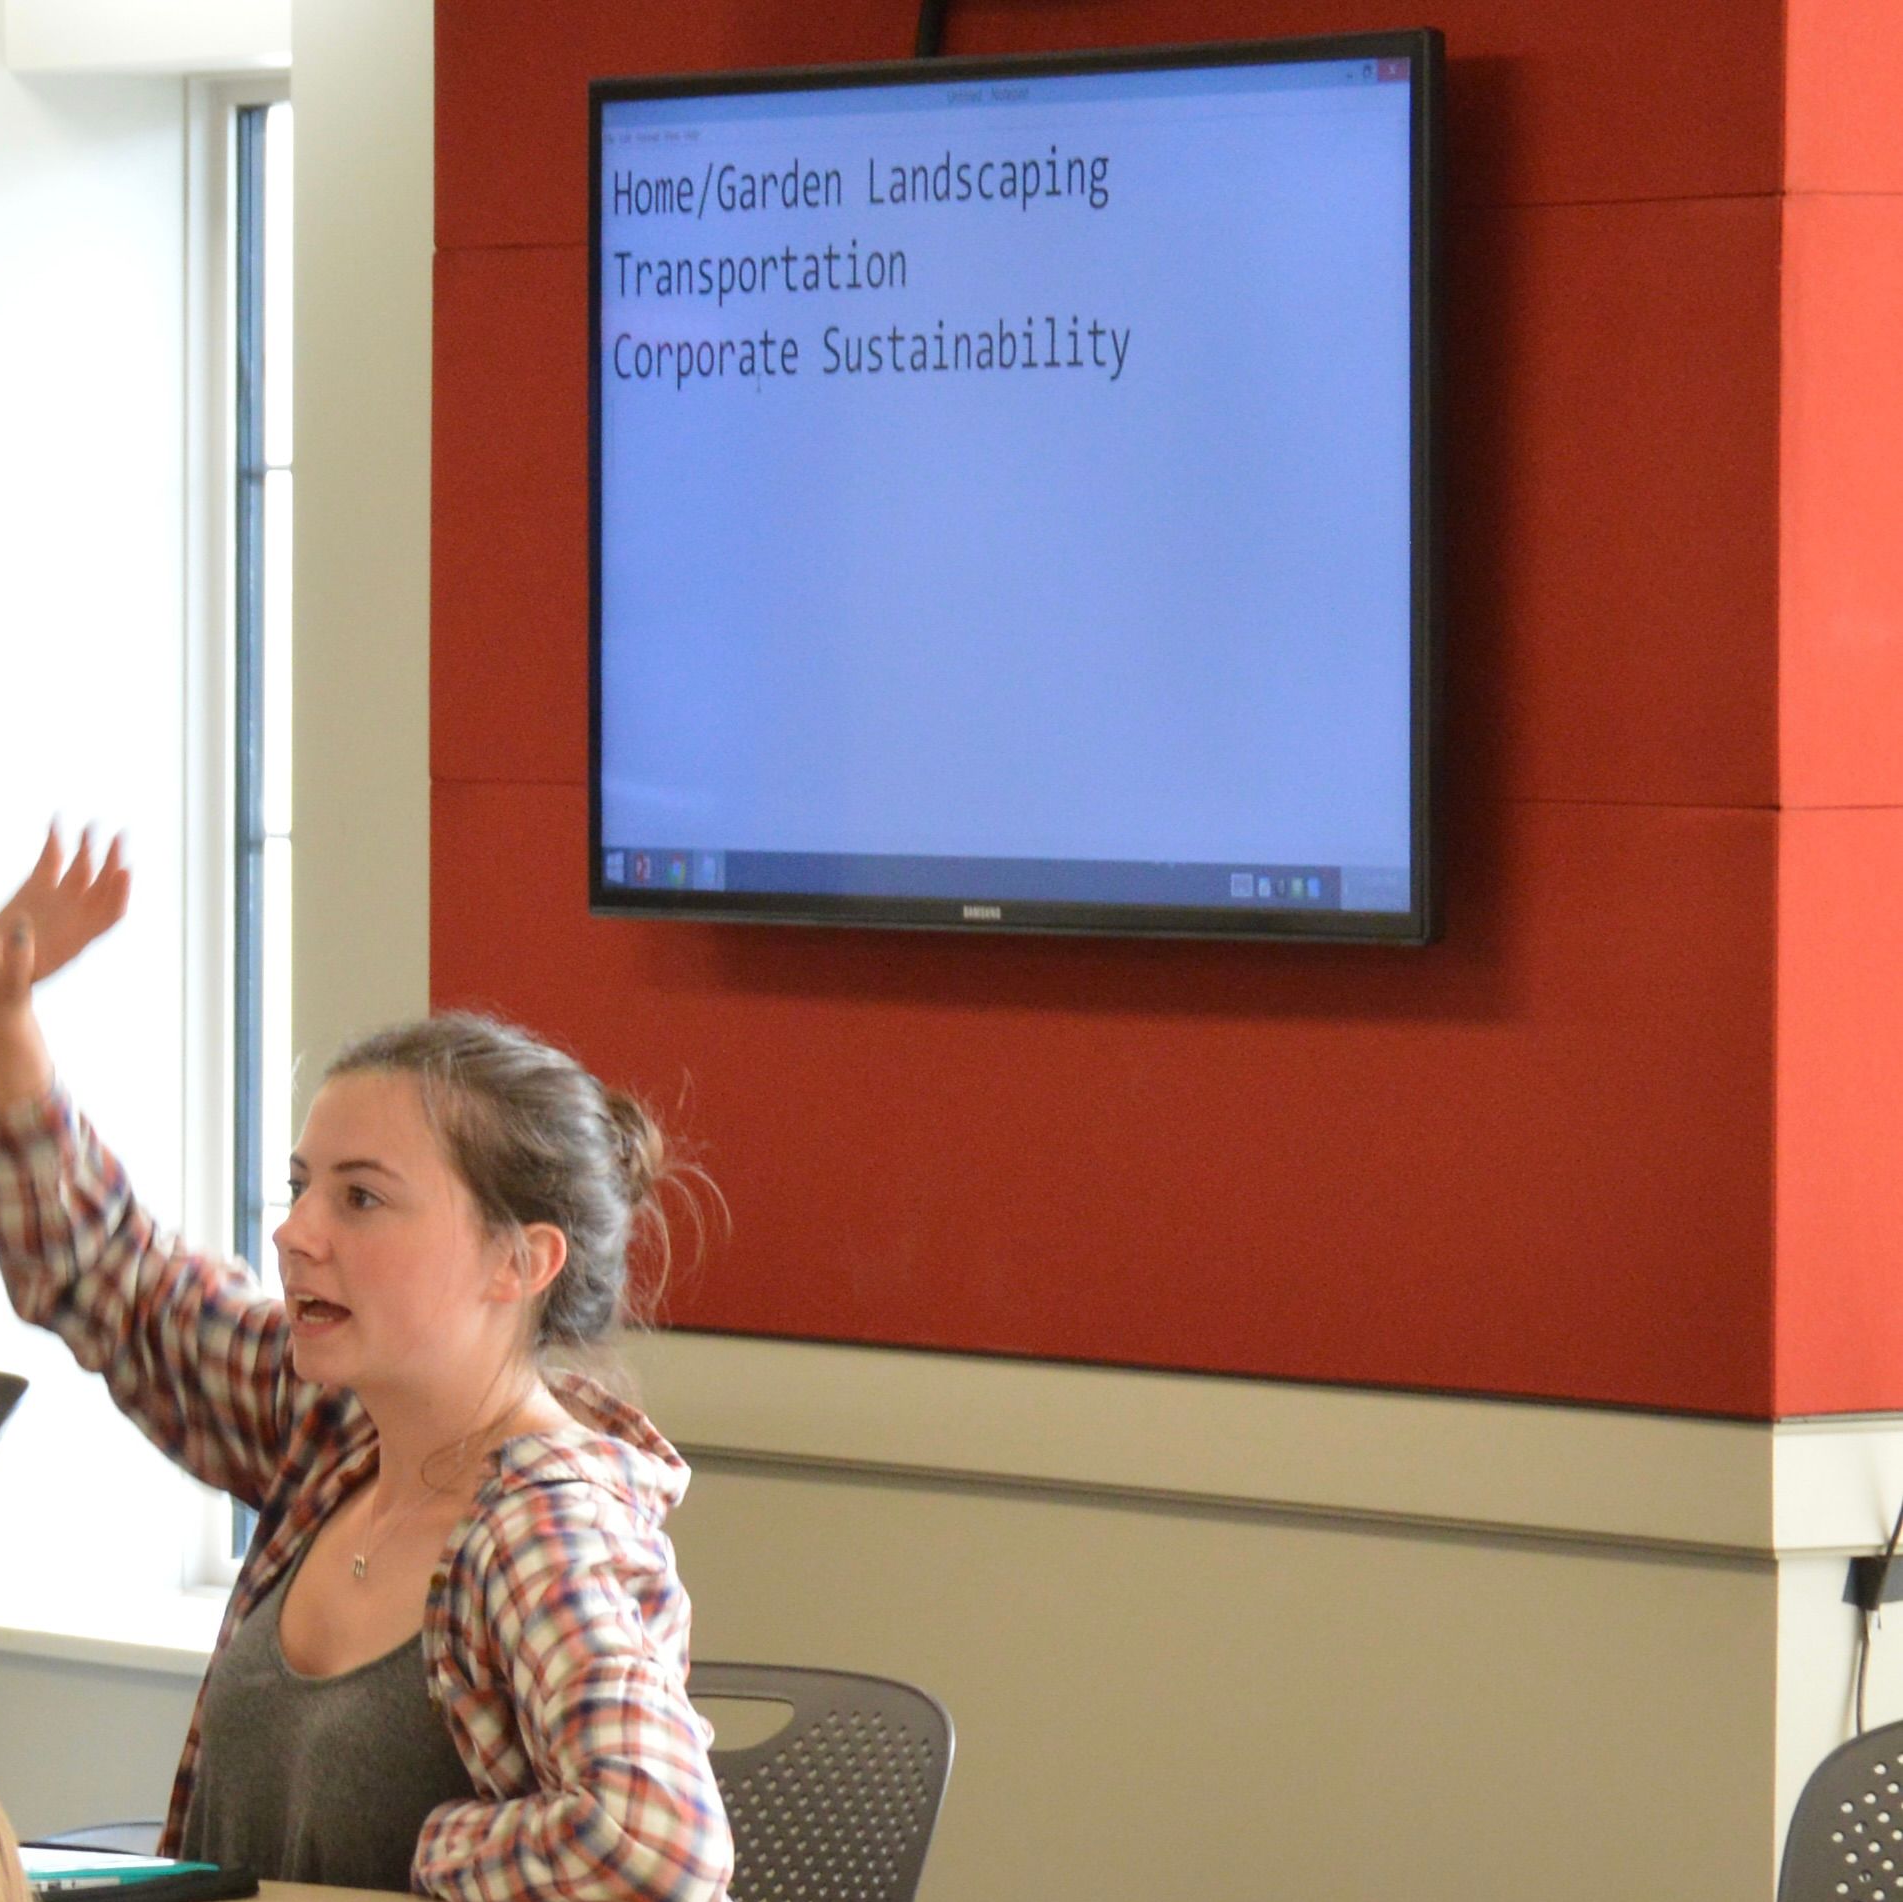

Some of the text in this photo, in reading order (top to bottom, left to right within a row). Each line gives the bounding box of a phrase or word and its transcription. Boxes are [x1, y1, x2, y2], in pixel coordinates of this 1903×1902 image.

[612, 145, 1111, 219] Home/Garden Landscaping
[613, 239, 907, 306] Transportation
[613, 316, 1131, 391] Corporate Sustainability
